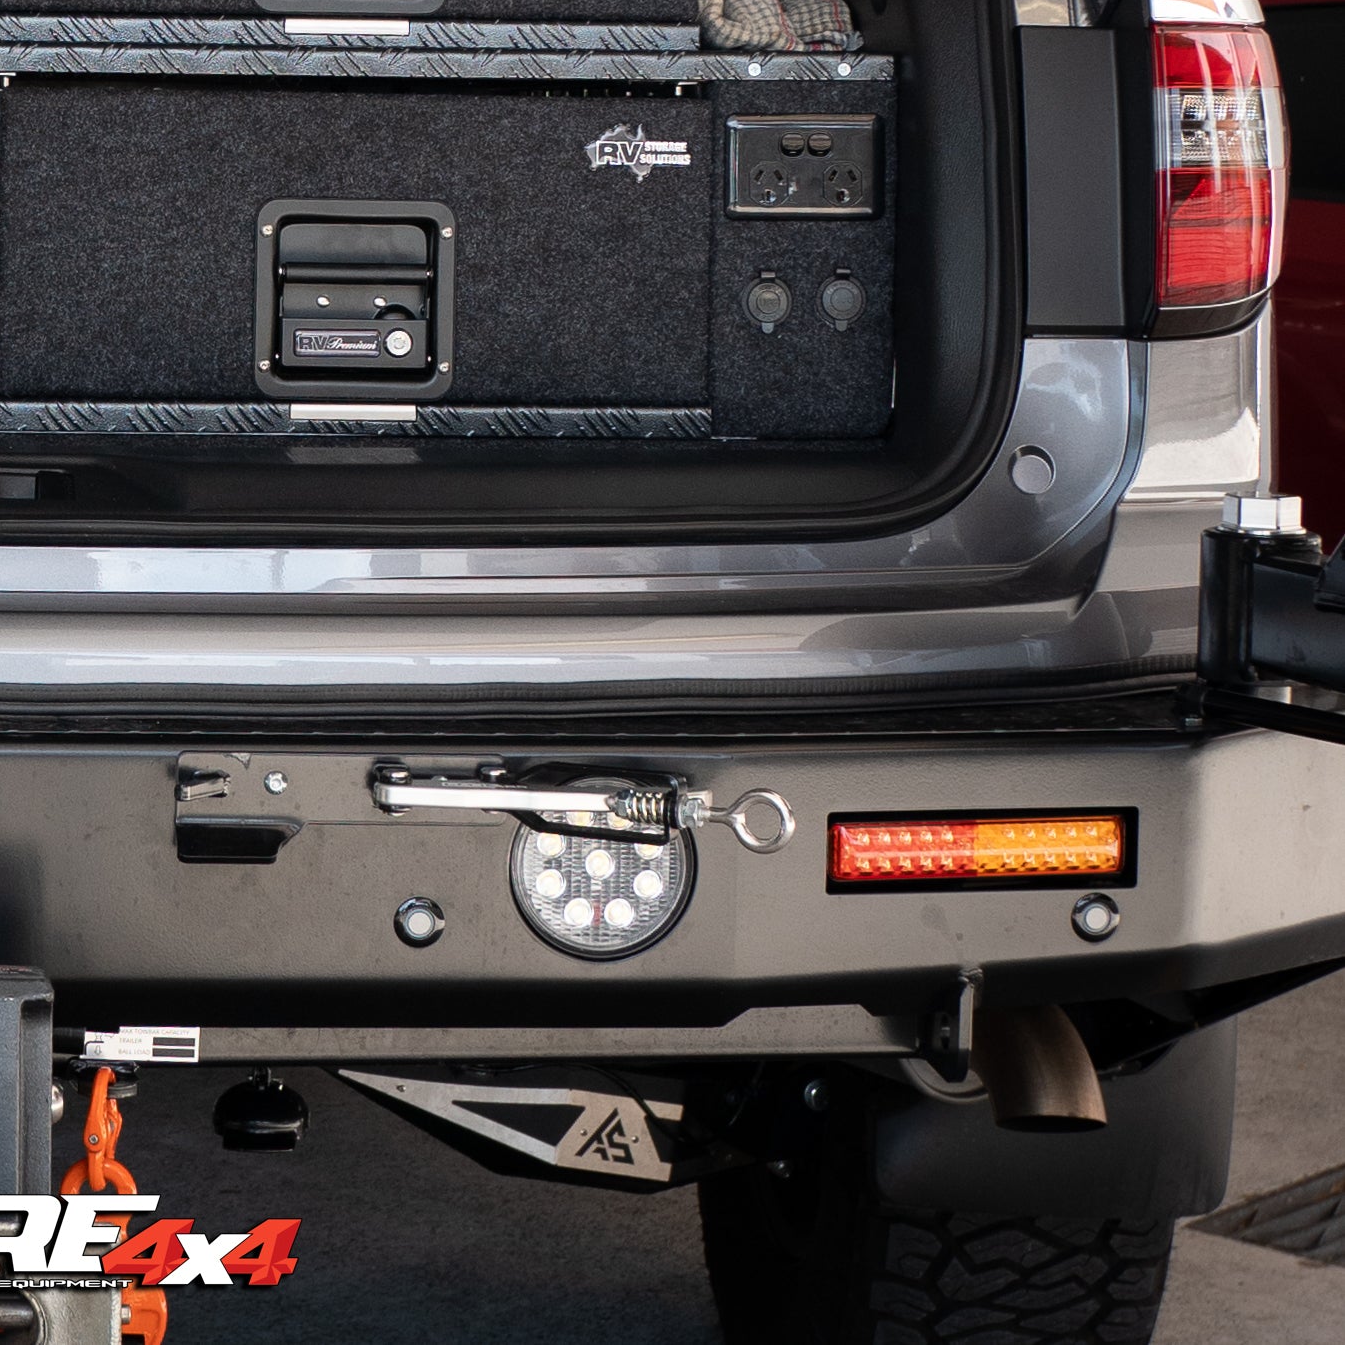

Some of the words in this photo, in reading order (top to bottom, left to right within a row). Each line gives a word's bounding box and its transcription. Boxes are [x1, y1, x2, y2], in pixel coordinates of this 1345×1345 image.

[596, 141, 643, 165] RV
[644, 141, 687, 152] STORAGE
[640, 154, 691, 165] SOLUTIONS
[299, 335, 328, 351] RV
[327, 337, 378, 350] Premium
